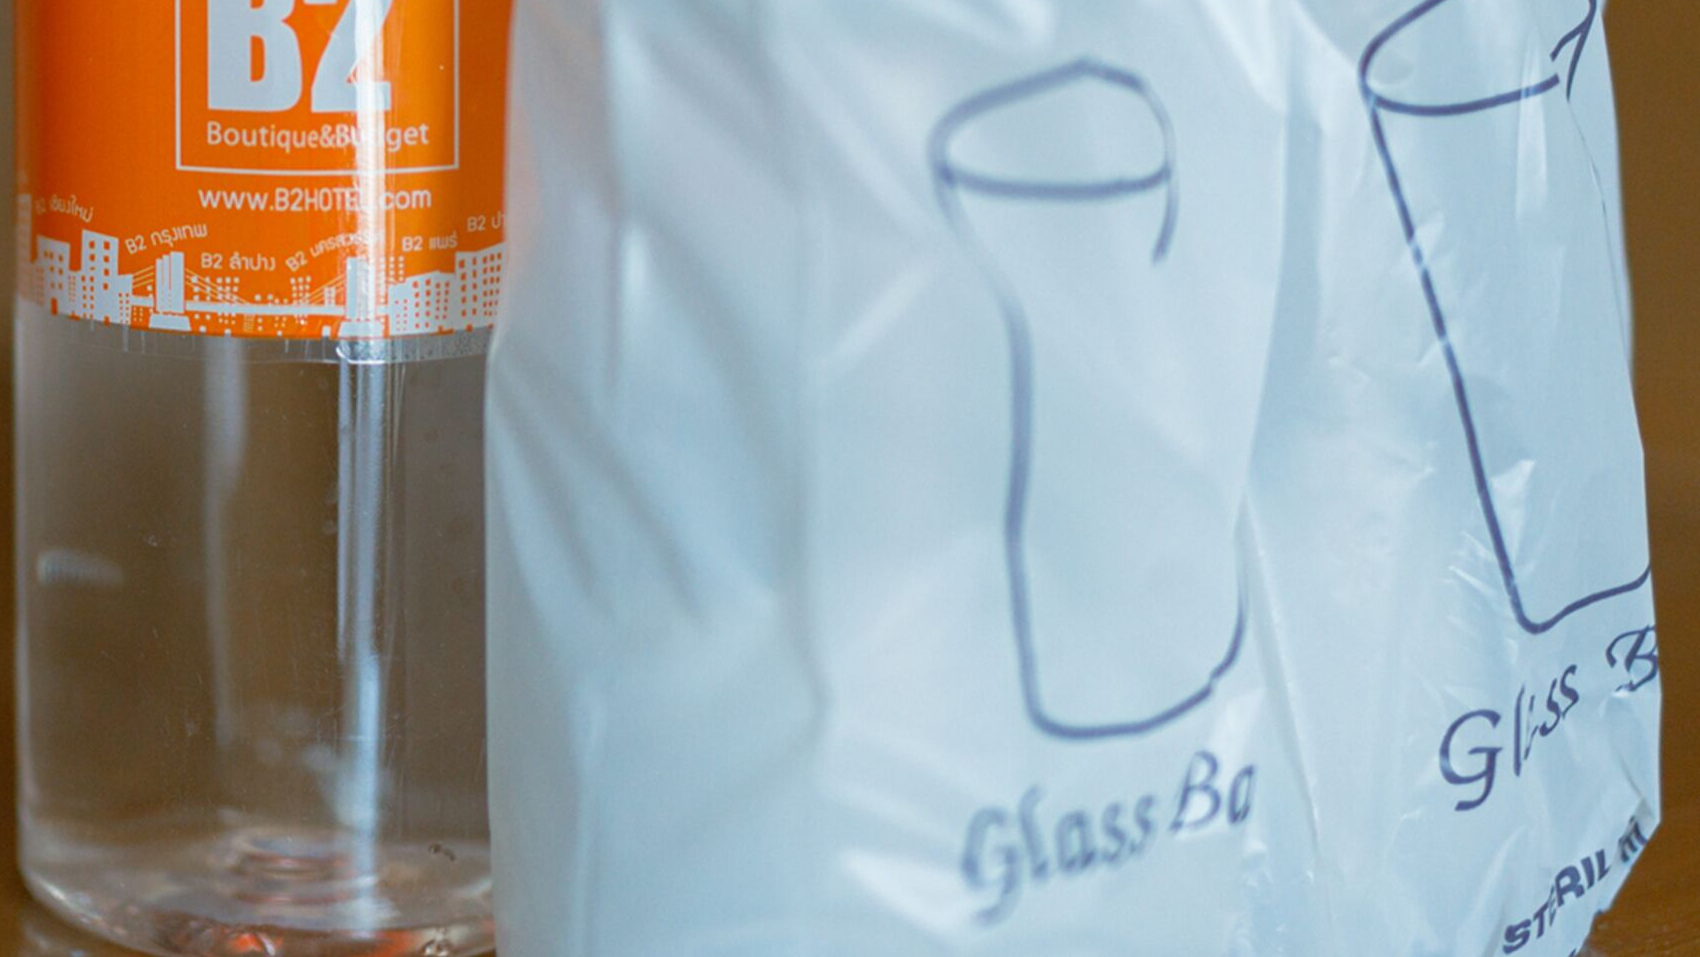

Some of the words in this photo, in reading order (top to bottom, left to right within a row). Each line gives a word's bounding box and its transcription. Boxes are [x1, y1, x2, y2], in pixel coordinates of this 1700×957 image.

[206, 121, 429, 154] Boutique&Buget
[198, 186, 432, 212] www.B2HOTELcom
[466, 214, 487, 233] B2
[124, 234, 148, 255] B2
[150, 223, 208, 248] กรุงเทพ
[401, 235, 424, 253] B2
[428, 229, 458, 251] แพร่
[200, 252, 223, 270] B2
[229, 250, 276, 272] ลำปาง
[285, 250, 309, 273] B2
[958, 782, 1158, 929] Glass
